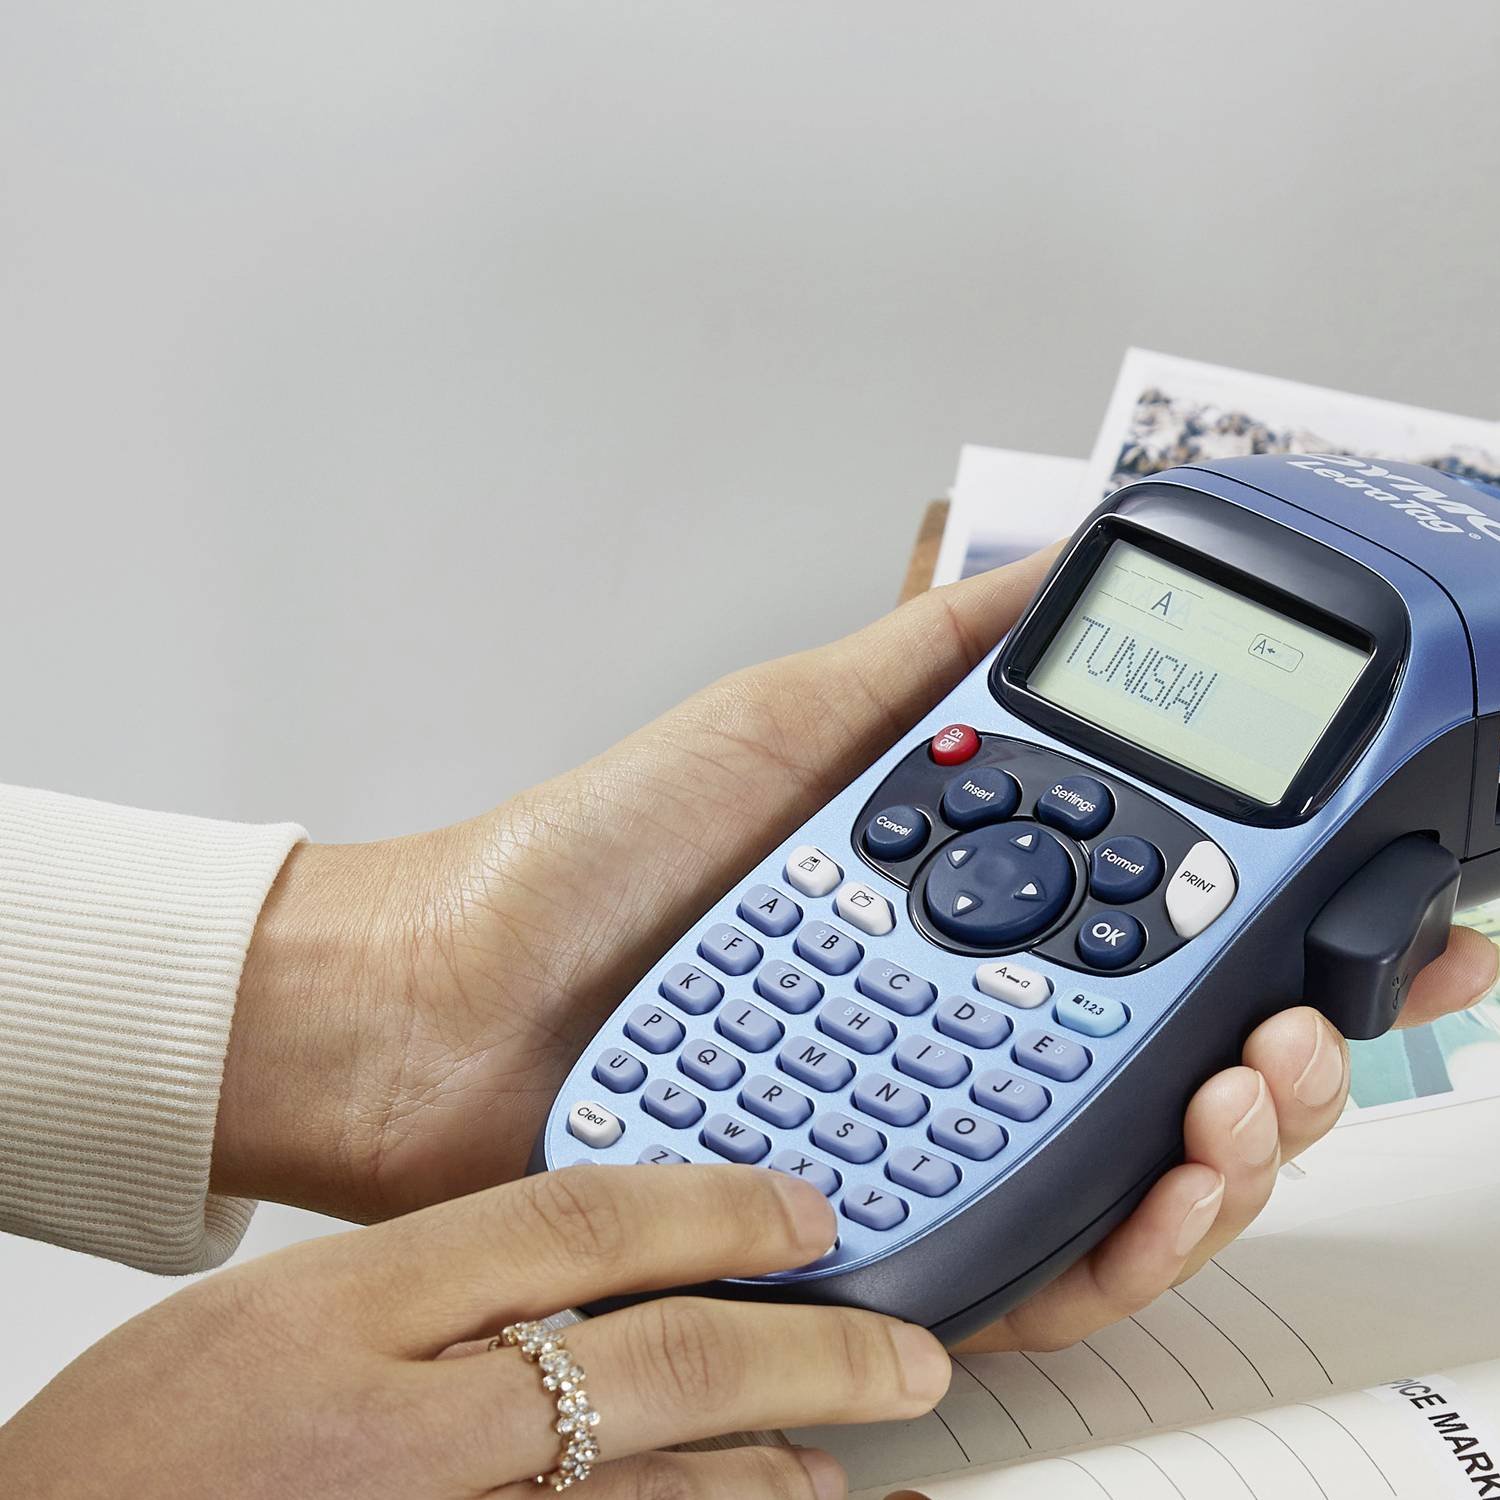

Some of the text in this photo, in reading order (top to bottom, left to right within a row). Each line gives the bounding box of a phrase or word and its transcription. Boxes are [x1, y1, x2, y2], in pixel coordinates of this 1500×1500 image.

[1151, 591, 1173, 616] A
[1066, 615, 1206, 721] TUNISIA
[949, 727, 964, 739] On
[962, 780, 995, 802] Insert
[1051, 784, 1096, 813] Settings
[876, 816, 913, 837] Cancel
[1101, 848, 1145, 877] Format
[1179, 869, 1216, 894] PRINT
[759, 898, 779, 913] A
[821, 934, 839, 950] B
[1092, 922, 1127, 947] OK
[723, 937, 743, 951] F
[679, 973, 701, 989] K
[779, 973, 800, 989] G
[888, 973, 910, 990] C
[643, 1013, 662, 1027] P
[736, 1010, 751, 1026] L
[953, 1002, 975, 1021] D
[847, 1012, 870, 1030] H
[916, 1045, 932, 1060] I
[1033, 1035, 1054, 1054] E
[698, 1049, 717, 1065] Q
[799, 1045, 828, 1067] M
[663, 1087, 680, 1101] V
[762, 1085, 783, 1102] R
[875, 1083, 900, 1103] N
[992, 1079, 1013, 1093] J
[577, 1106, 607, 1126] Clear
[723, 1121, 746, 1138] W
[836, 1122, 854, 1138] S
[954, 1117, 976, 1135] O
[650, 1150, 669, 1164] Z
[911, 1155, 930, 1171] T
[790, 1157, 813, 1176] X
[863, 1190, 883, 1207] Y
